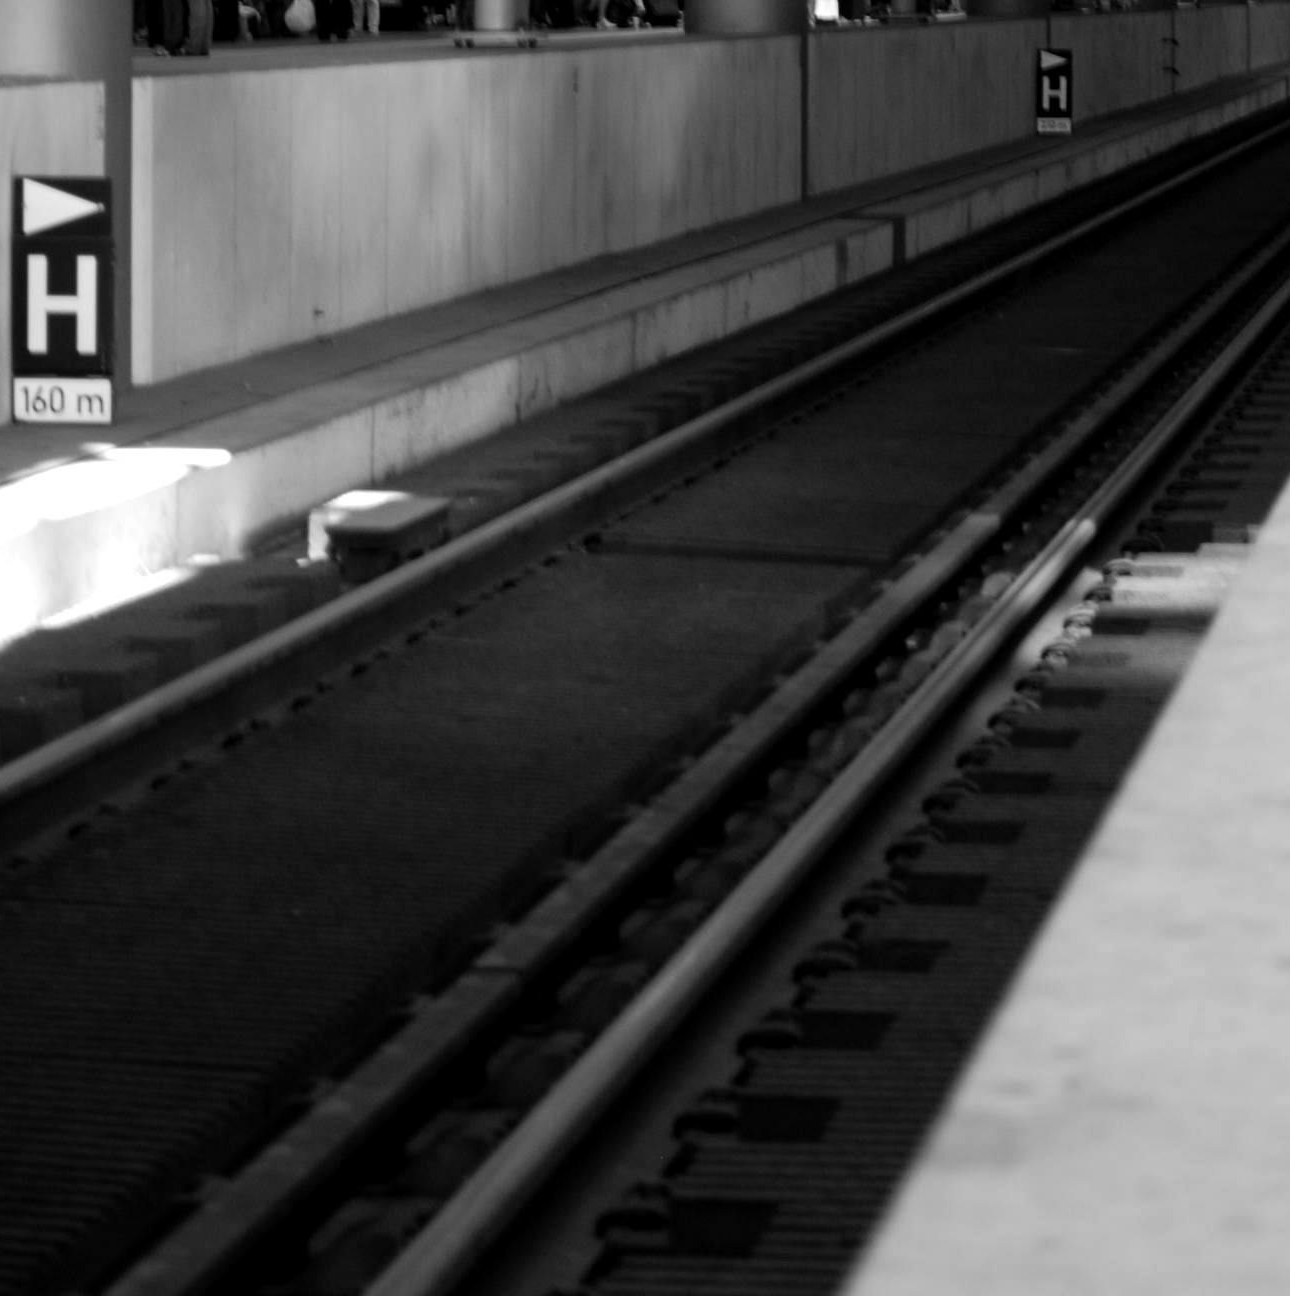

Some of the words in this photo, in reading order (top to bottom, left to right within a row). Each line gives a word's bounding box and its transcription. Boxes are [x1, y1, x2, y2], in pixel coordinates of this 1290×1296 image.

[1041, 75, 1068, 112] H
[27, 254, 97, 353] H
[21, 385, 65, 415] 160
[76, 393, 105, 415] m
